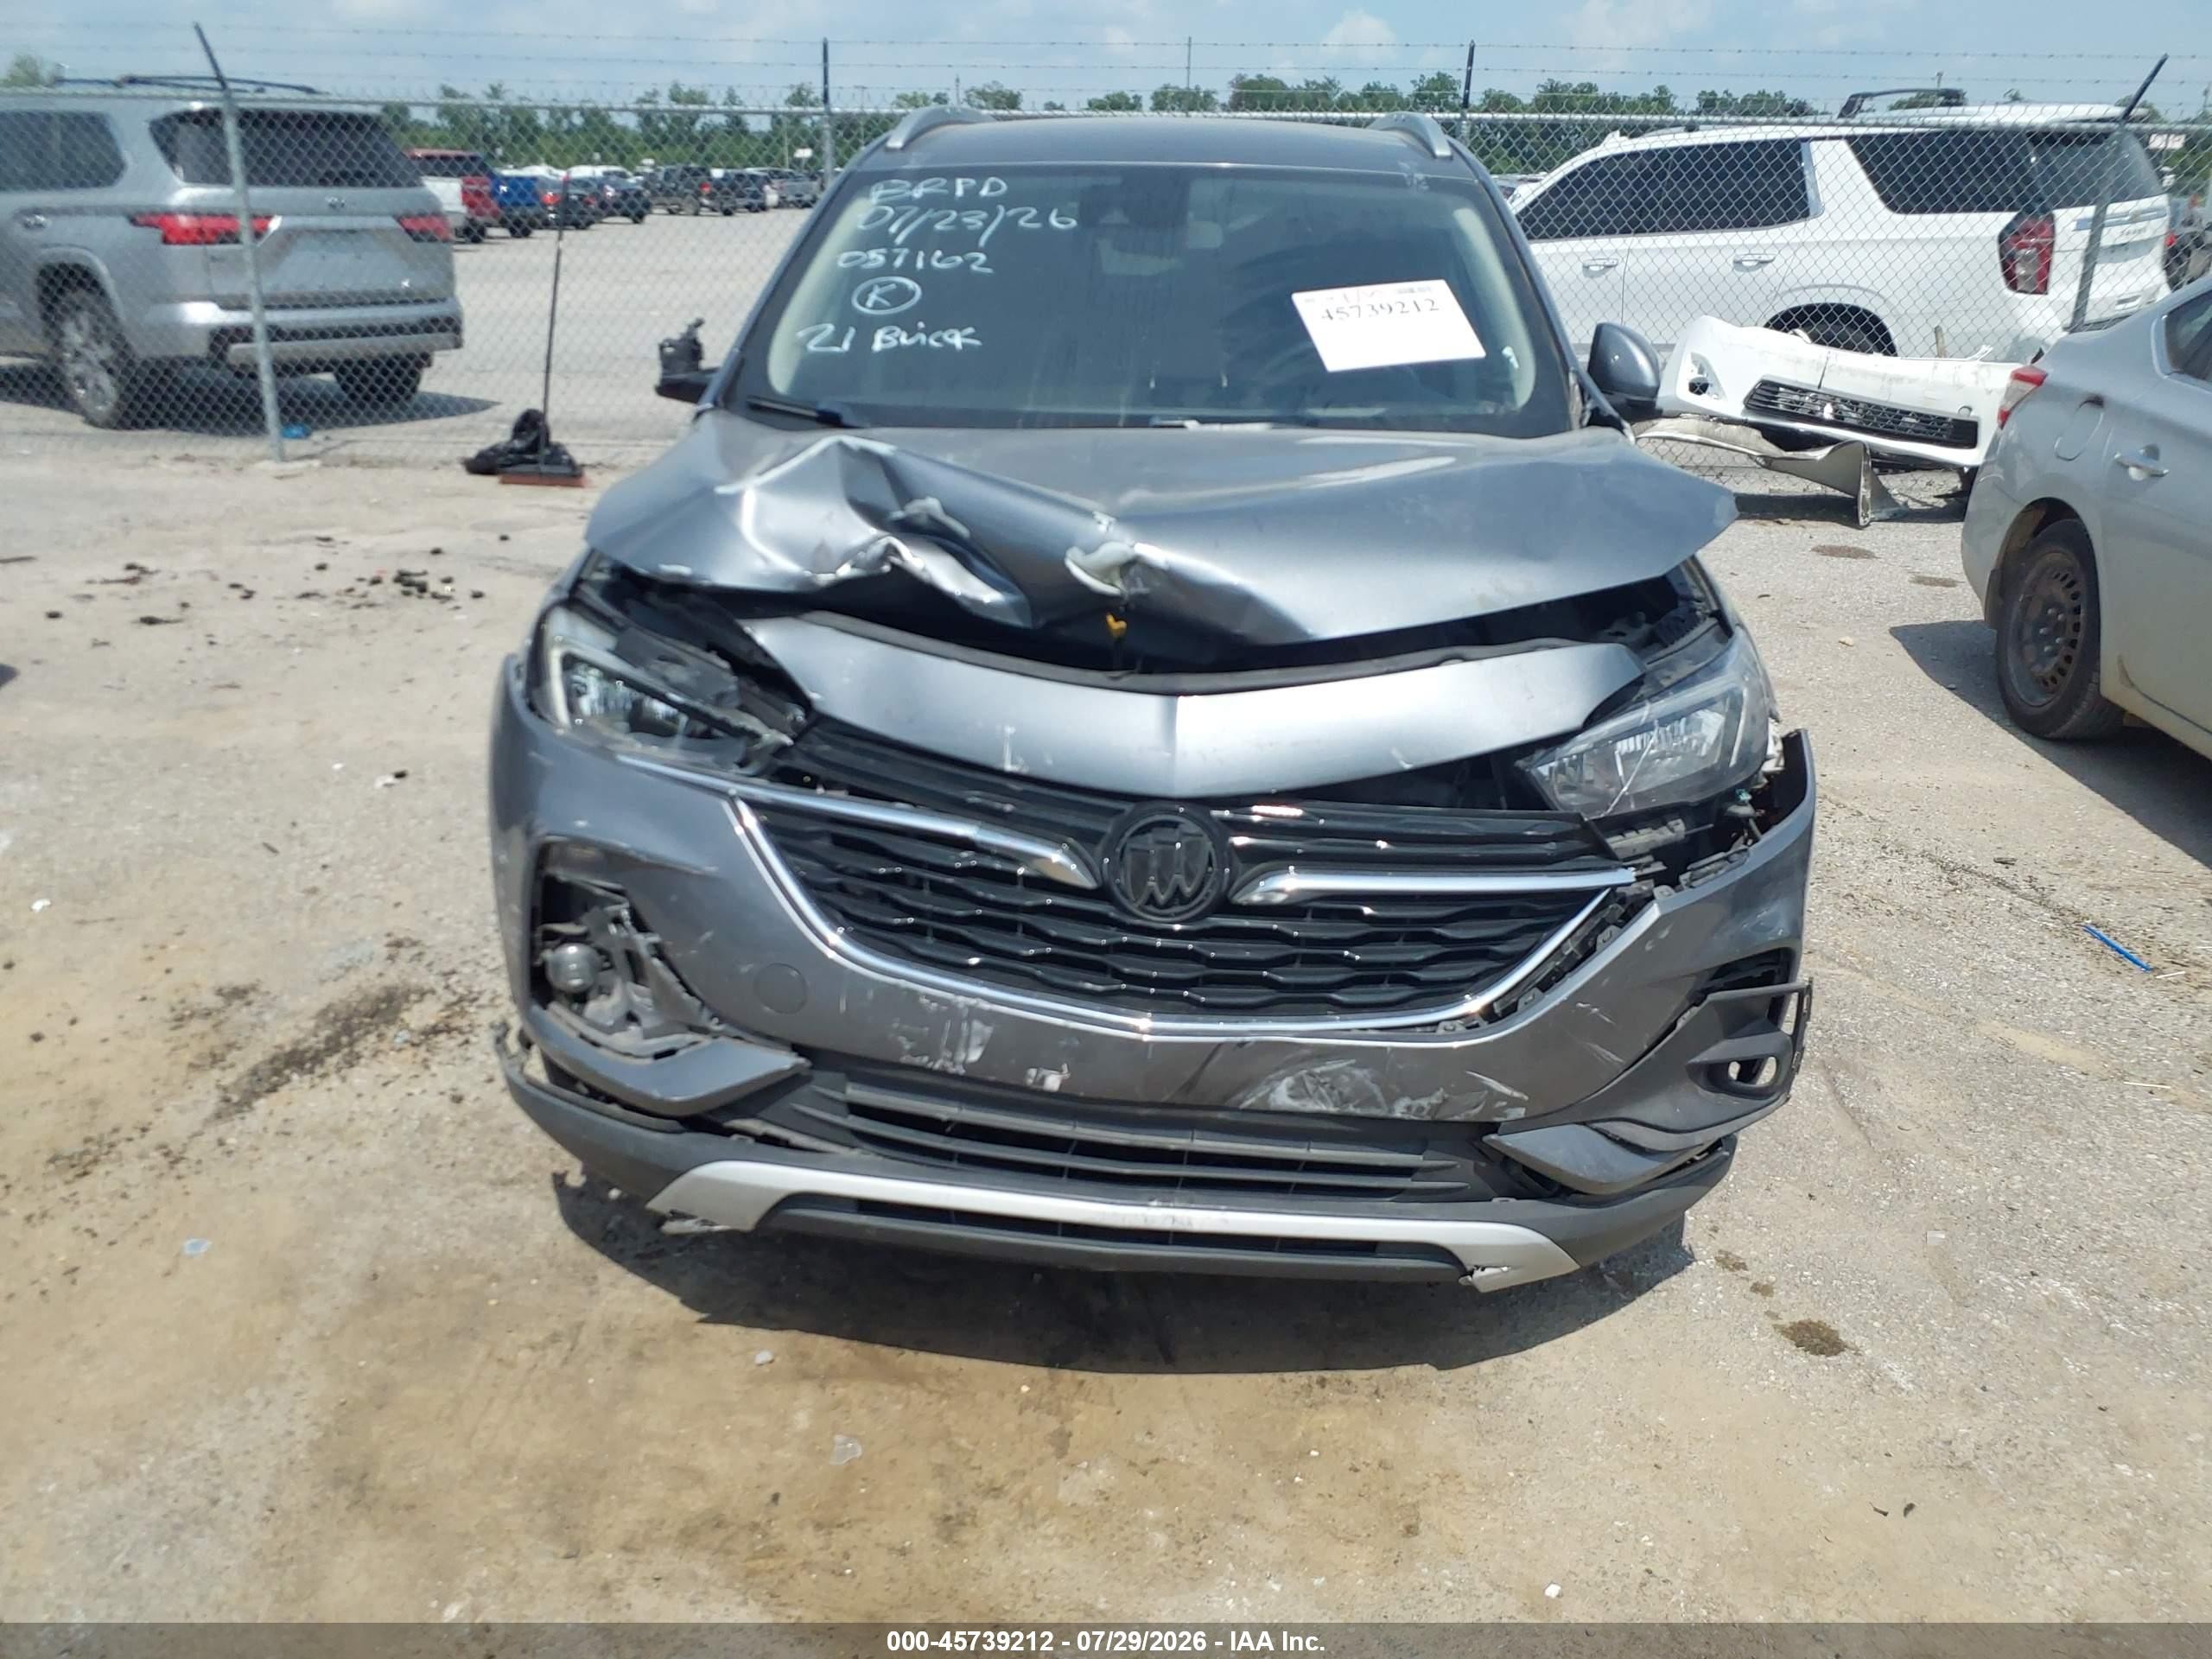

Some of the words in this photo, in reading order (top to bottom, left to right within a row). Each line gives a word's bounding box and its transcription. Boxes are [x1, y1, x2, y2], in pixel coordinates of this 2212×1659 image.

[869, 176, 1007, 204] BRPD
[857, 204, 1078, 247] 07/23/26
[796, 322, 856, 353] 21
